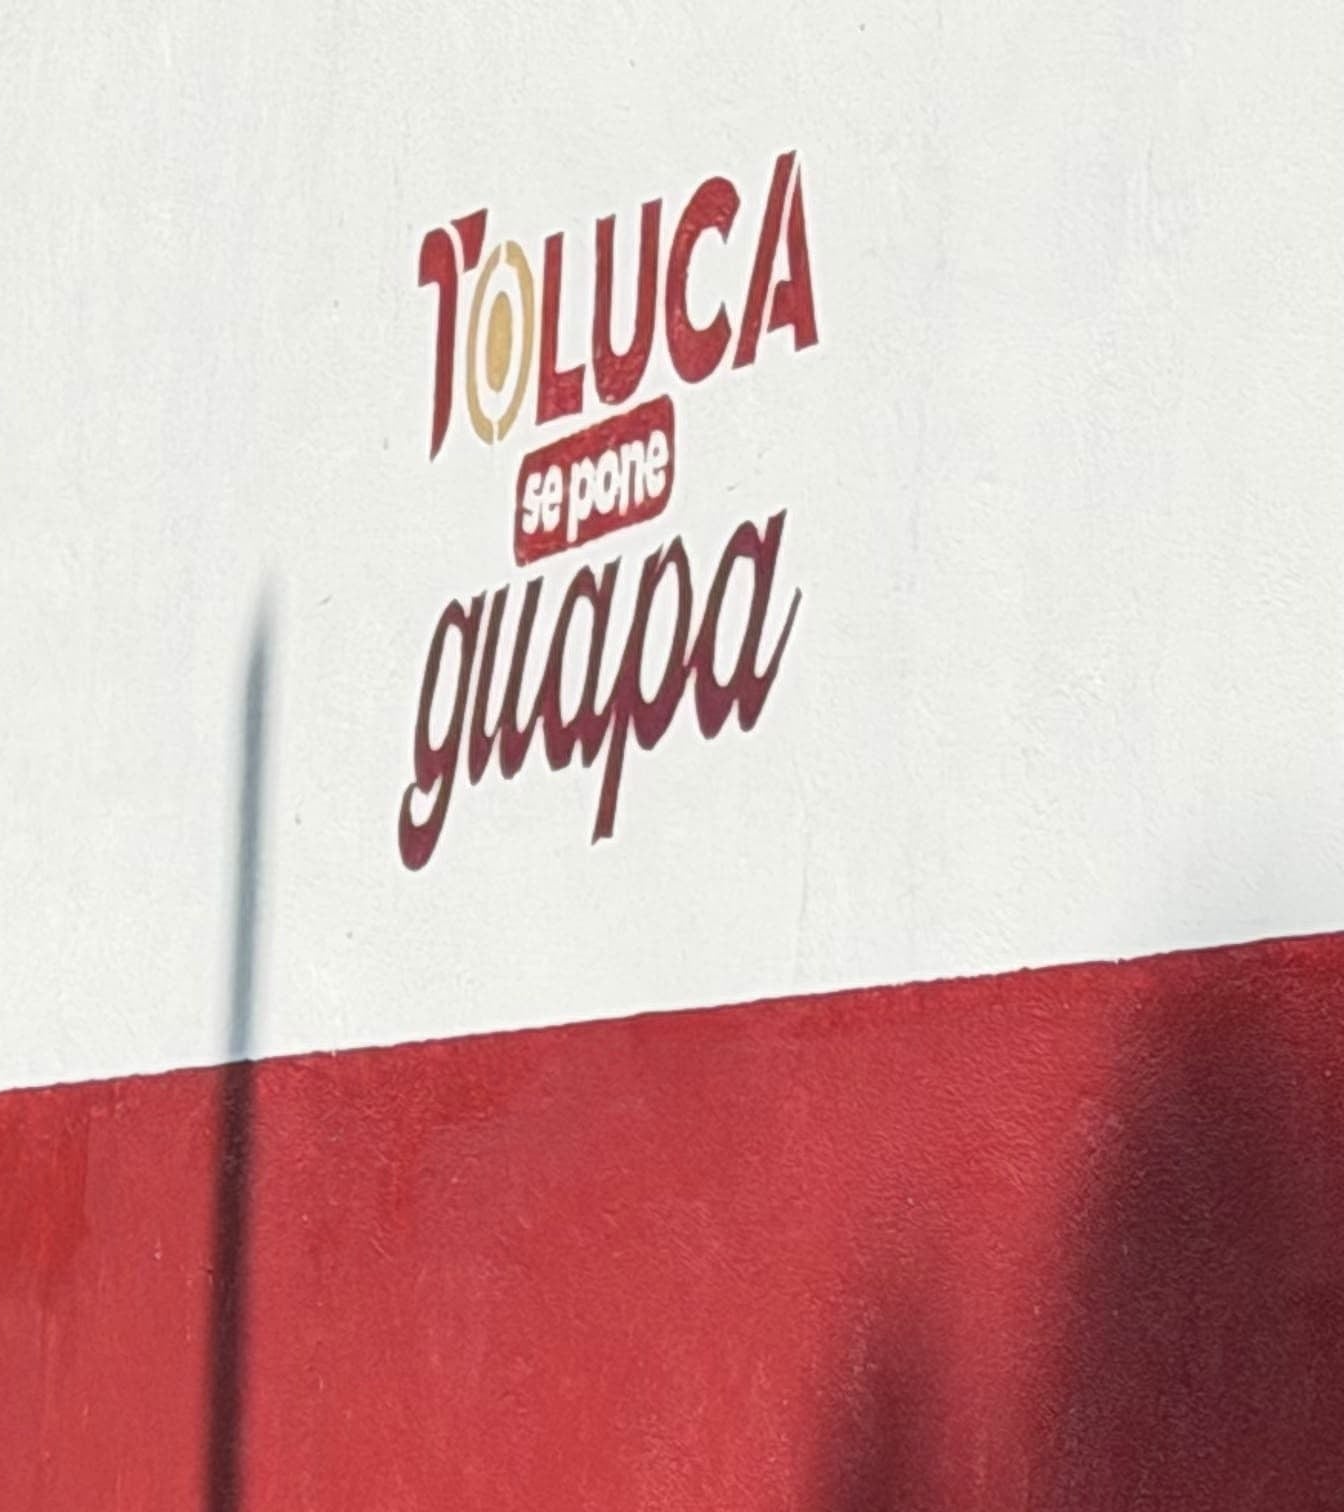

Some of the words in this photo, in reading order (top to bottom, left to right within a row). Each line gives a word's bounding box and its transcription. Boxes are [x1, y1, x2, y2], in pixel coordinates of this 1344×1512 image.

[417, 149, 820, 462] TOLUCA
[521, 464, 564, 535] se
[566, 429, 670, 543] pone
[398, 508, 803, 872] guapa
